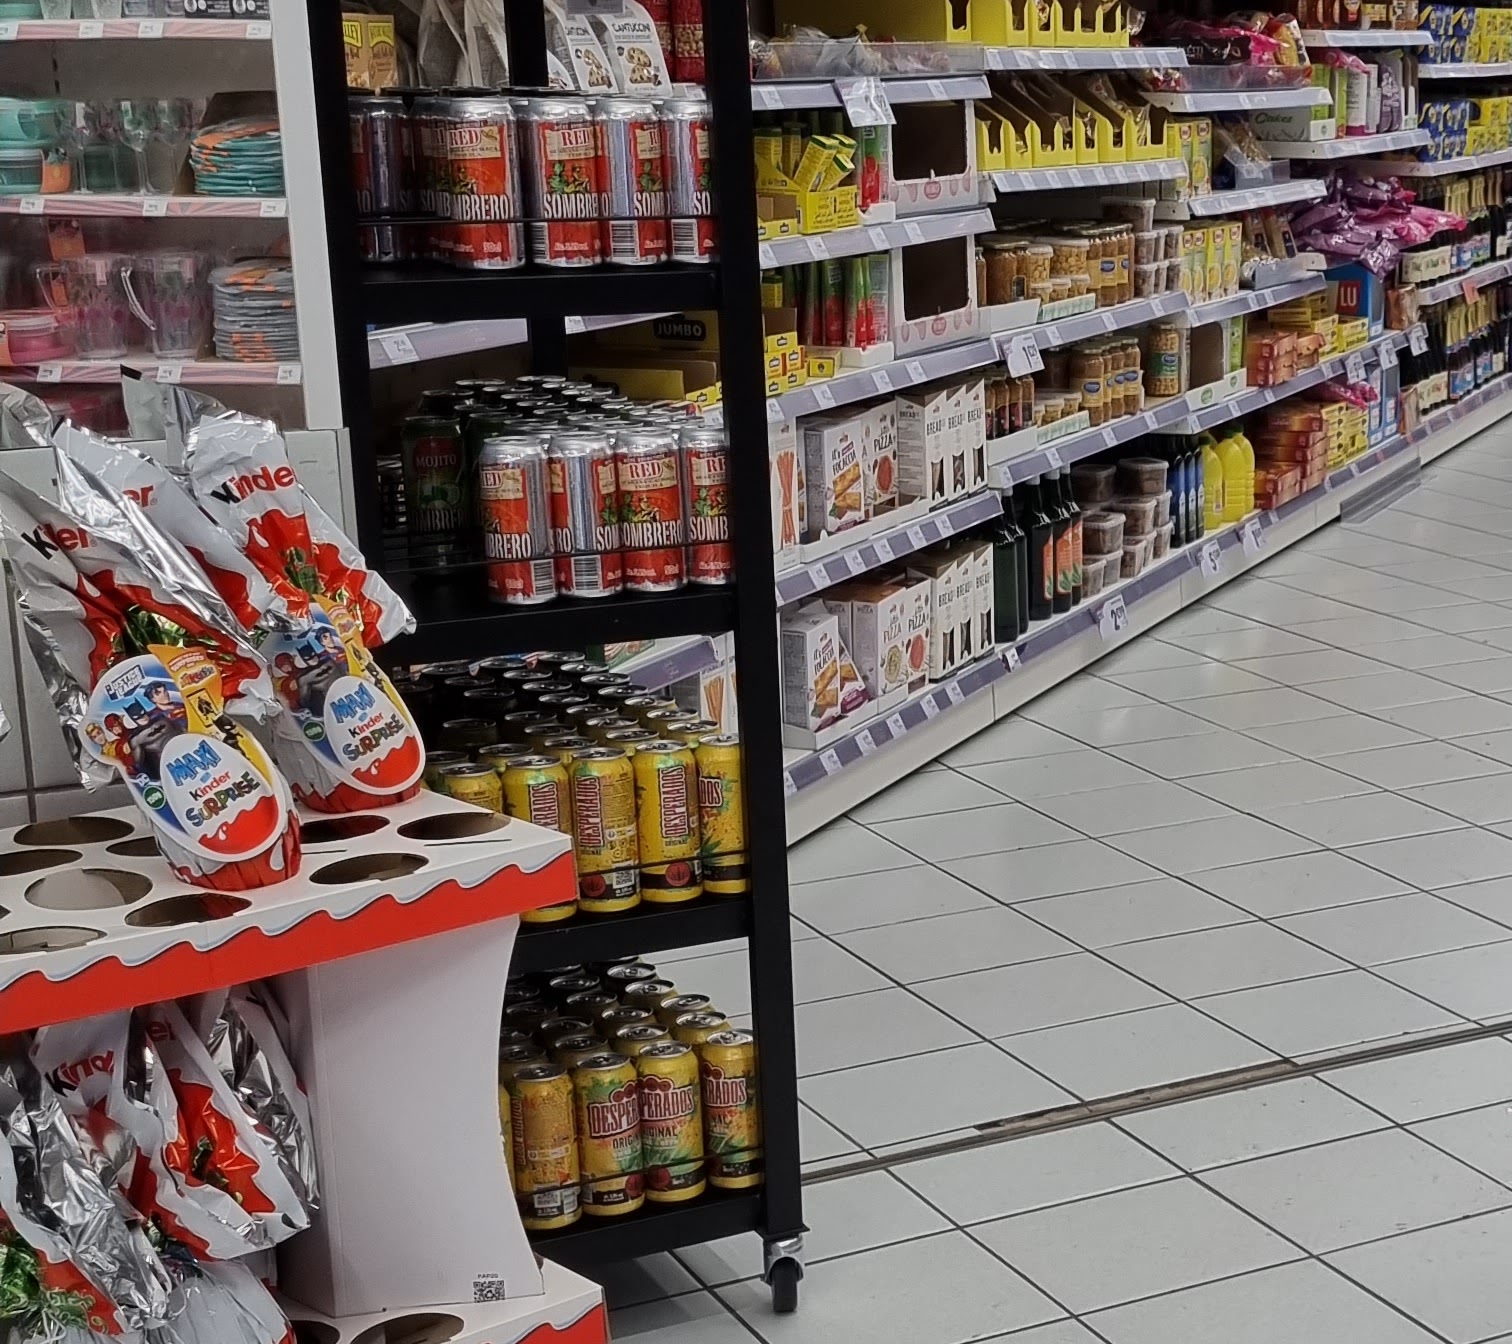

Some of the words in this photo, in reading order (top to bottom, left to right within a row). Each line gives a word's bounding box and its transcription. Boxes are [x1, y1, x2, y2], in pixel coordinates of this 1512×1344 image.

[448, 128, 481, 148] RED
[543, 191, 598, 219] SOMBRE
[1341, 287, 1357, 307] LU
[657, 323, 702, 336] JUMBO
[874, 434, 893, 453] PIZZA
[628, 459, 662, 479] RED
[330, 682, 376, 724] MAXI
[342, 714, 405, 762] SURPRISE
[165, 739, 222, 787] MAXI
[186, 771, 261, 827] SURPRISE
[576, 775, 604, 847] DESPERADOS
[659, 765, 689, 838] DESPERADOS
